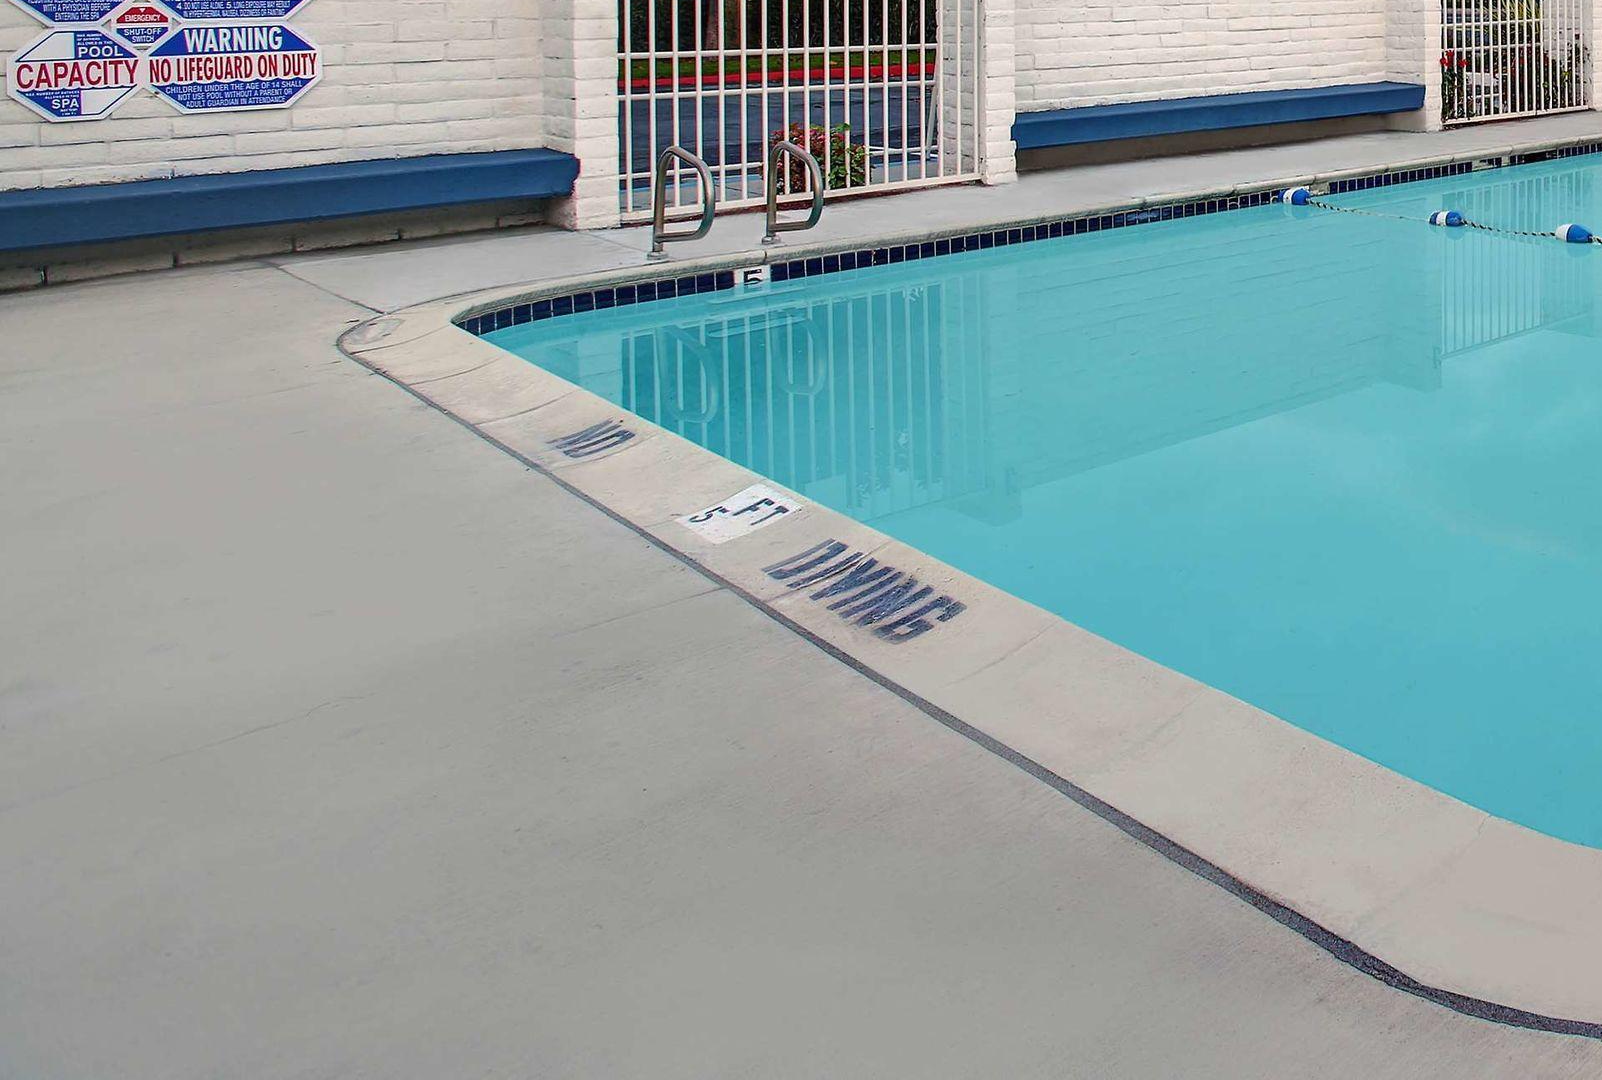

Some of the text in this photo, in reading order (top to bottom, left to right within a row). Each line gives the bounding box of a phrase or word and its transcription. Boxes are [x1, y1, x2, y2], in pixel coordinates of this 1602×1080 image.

[125, 14, 161, 22] EMERGENCY
[124, 27, 162, 36] SHUT-OFF
[132, 35, 155, 43] SWITCH
[183, 26, 283, 53] WARNING
[78, 46, 124, 58] POOL
[16, 59, 139, 89] CAPACITY
[149, 53, 317, 83] NO LIFEGUARD ON DUTY
[165, 85, 203, 94] CHILDREN
[204, 84, 229, 92] UNDER
[245, 82, 259, 90] AGE
[281, 80, 303, 88] SHALL
[177, 93, 191, 101] NOT
[192, 92, 206, 100] USE
[206, 92, 223, 100] POOL
[224, 90, 253, 99] WITHOUT
[186, 95, 286, 108] ADULT GUARDIAN IN ATTENDANCE
[51, 98, 79, 109] SPA
[688, 497, 790, 527] 5 FT
[761, 537, 968, 645] DIVING
